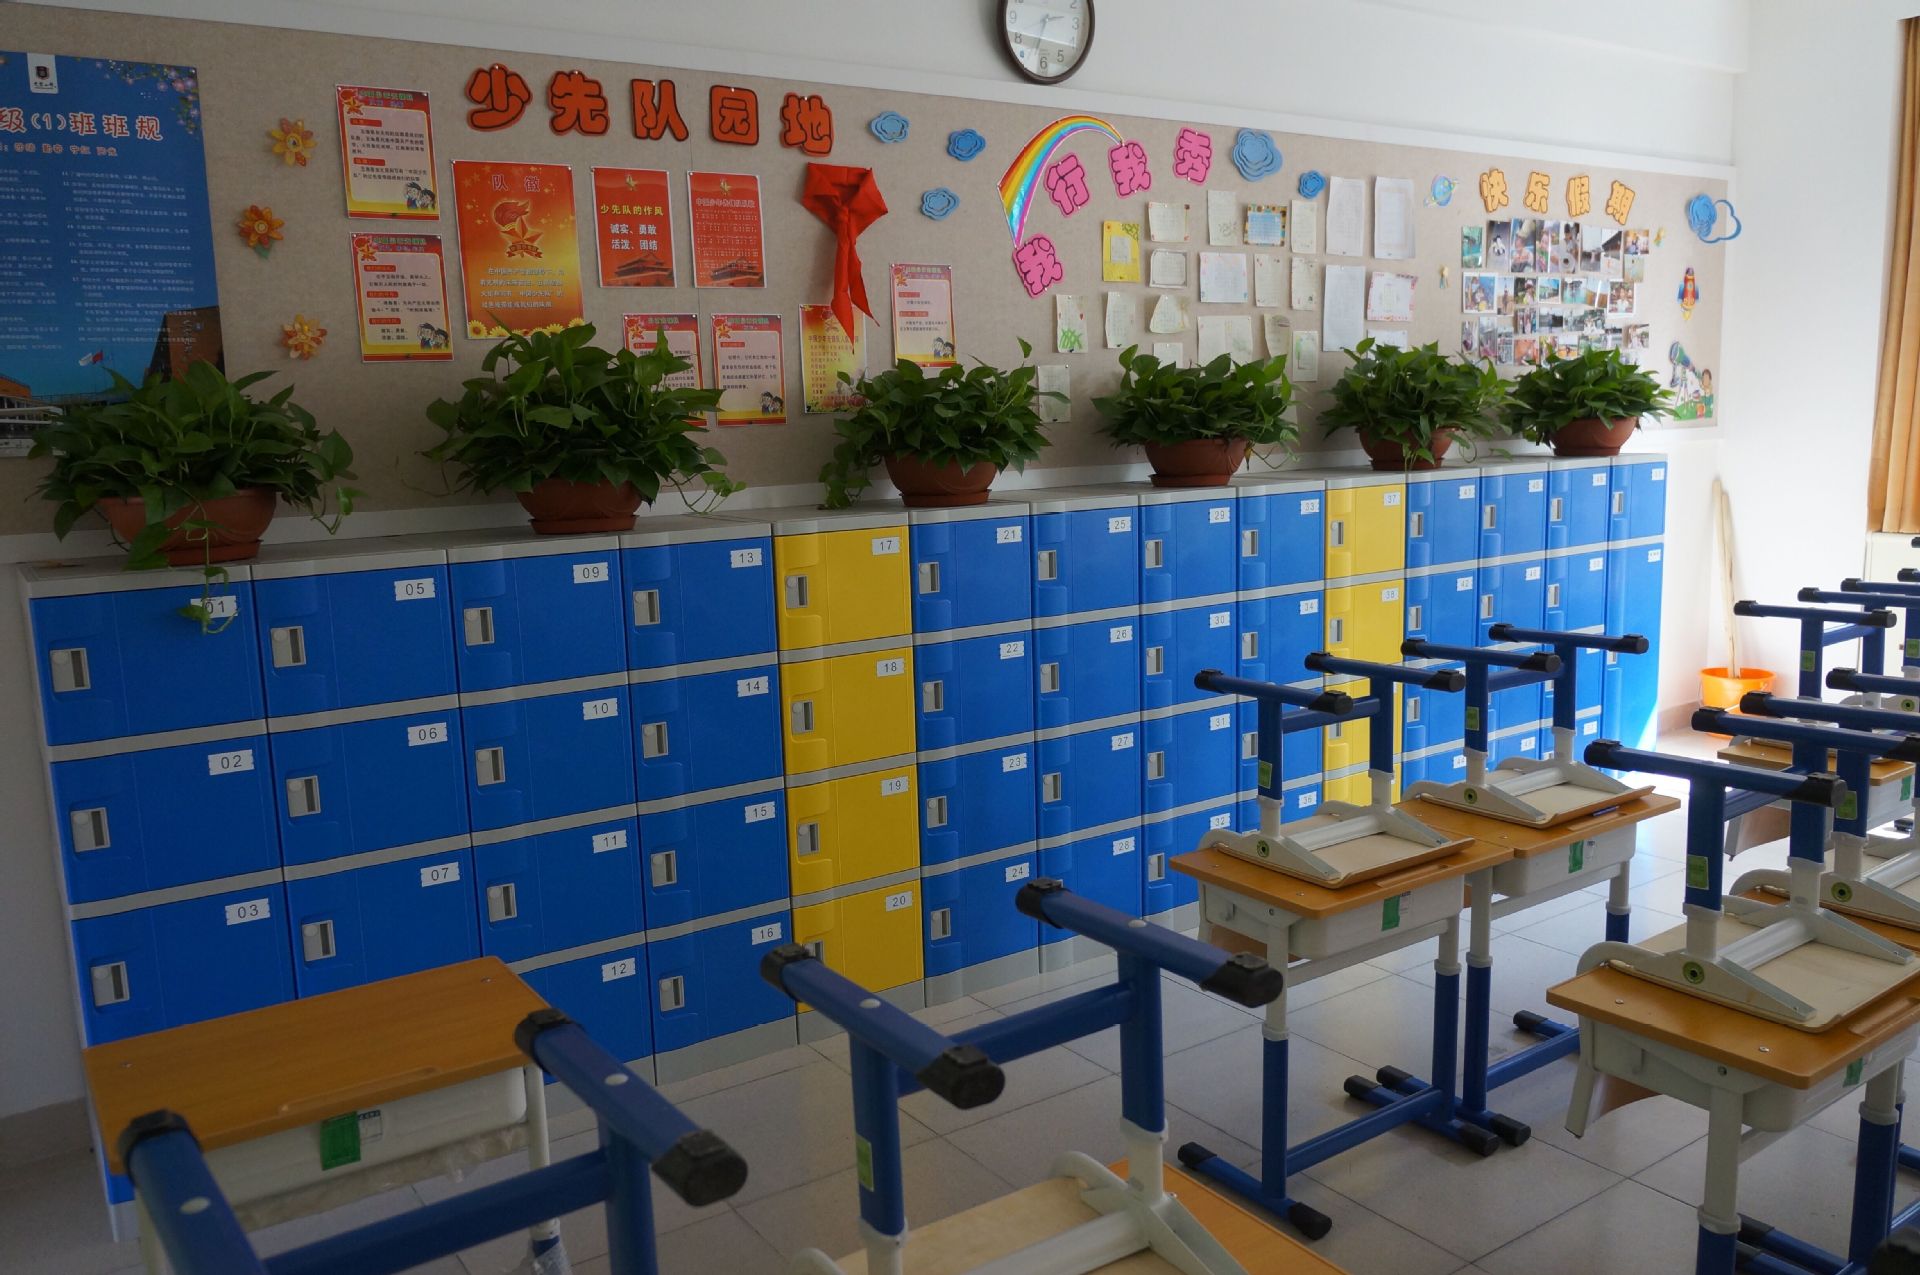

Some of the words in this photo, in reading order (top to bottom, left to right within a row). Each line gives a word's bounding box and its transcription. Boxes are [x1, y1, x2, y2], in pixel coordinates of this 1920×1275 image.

[1009, 10, 1017, 24] 9
[1072, 17, 1079, 30] 3
[1014, 32, 1022, 44] 8
[1057, 50, 1064, 62] 5
[1040, 57, 1047, 69] 6
[466, 64, 834, 154] 少先队园地
[1479, 168, 1636, 226] 快乐假期
[600, 204, 664, 217] 少先队的作风
[1387, 495, 1397, 504] 37
[1304, 501, 1315, 511] 33
[1214, 510, 1225, 520] 29
[1114, 520, 1126, 530] 25
[1003, 529, 1016, 539] 21
[879, 540, 893, 551] 17
[739, 552, 754, 564] 13
[583, 566, 600, 579] 09
[405, 583, 426, 595] 05
[1386, 590, 1395, 600] 38
[1304, 602, 1314, 612] 34
[1214, 615, 1225, 625] 30
[1116, 629, 1127, 639] 26
[1006, 643, 1019, 653] 22
[883, 662, 898, 673] 18
[746, 680, 761, 692] 14
[593, 702, 609, 714] 10
[1215, 717, 1225, 727] 31
[418, 728, 438, 740] 06
[1117, 736, 1128, 746] 27
[221, 755, 242, 769] 02
[1009, 757, 1021, 768] 23
[888, 780, 902, 791] 19
[1303, 794, 1312, 805] 36
[753, 806, 767, 818] 15
[1215, 817, 1225, 827] 32
[603, 835, 618, 848] 11
[1118, 841, 1130, 851] 28
[431, 868, 449, 880] 07
[1011, 867, 1024, 877] 24
[893, 895, 907, 906] 20
[237, 904, 259, 919] 03
[759, 927, 774, 939] 16
[611, 963, 627, 975] 12
